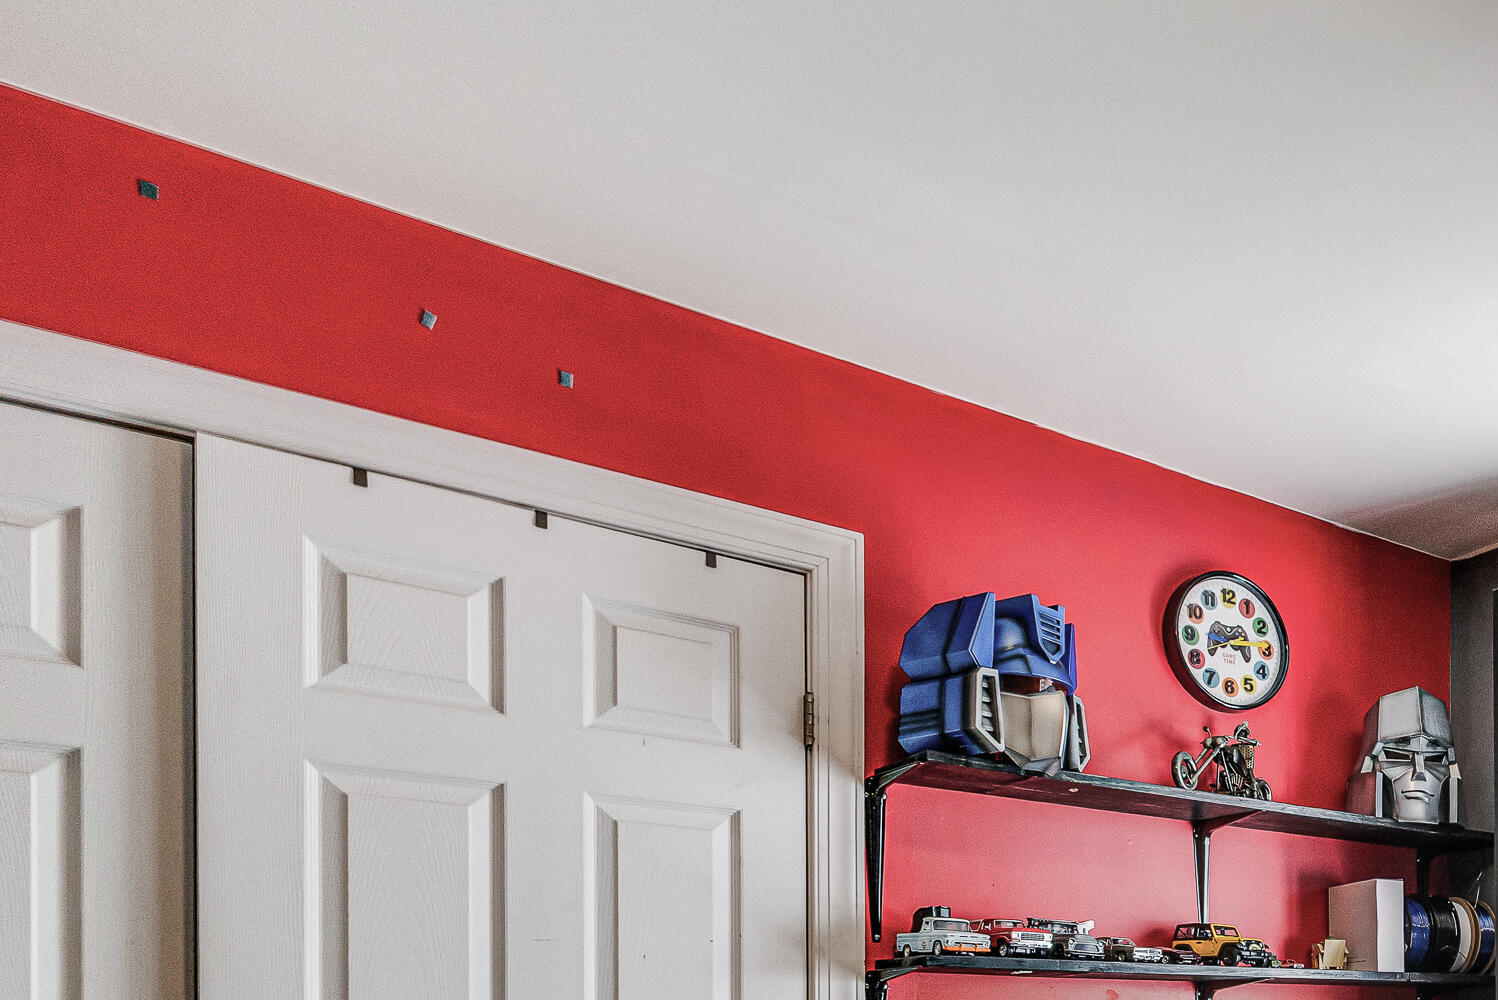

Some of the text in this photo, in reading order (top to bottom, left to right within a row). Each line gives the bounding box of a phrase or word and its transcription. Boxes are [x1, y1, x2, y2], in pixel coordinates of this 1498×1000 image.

[1202, 589, 1216, 607] 11
[1221, 588, 1237, 604] 12
[1187, 603, 1203, 620] 10
[1243, 600, 1251, 615] 1
[1185, 626, 1196, 641] 9
[1257, 619, 1267, 635] 2
[1190, 649, 1202, 665] 8
[1204, 669, 1216, 685] 7
[1256, 664, 1267, 680] 4
[1224, 680, 1235, 694] 6
[1243, 678, 1254, 692] 5
